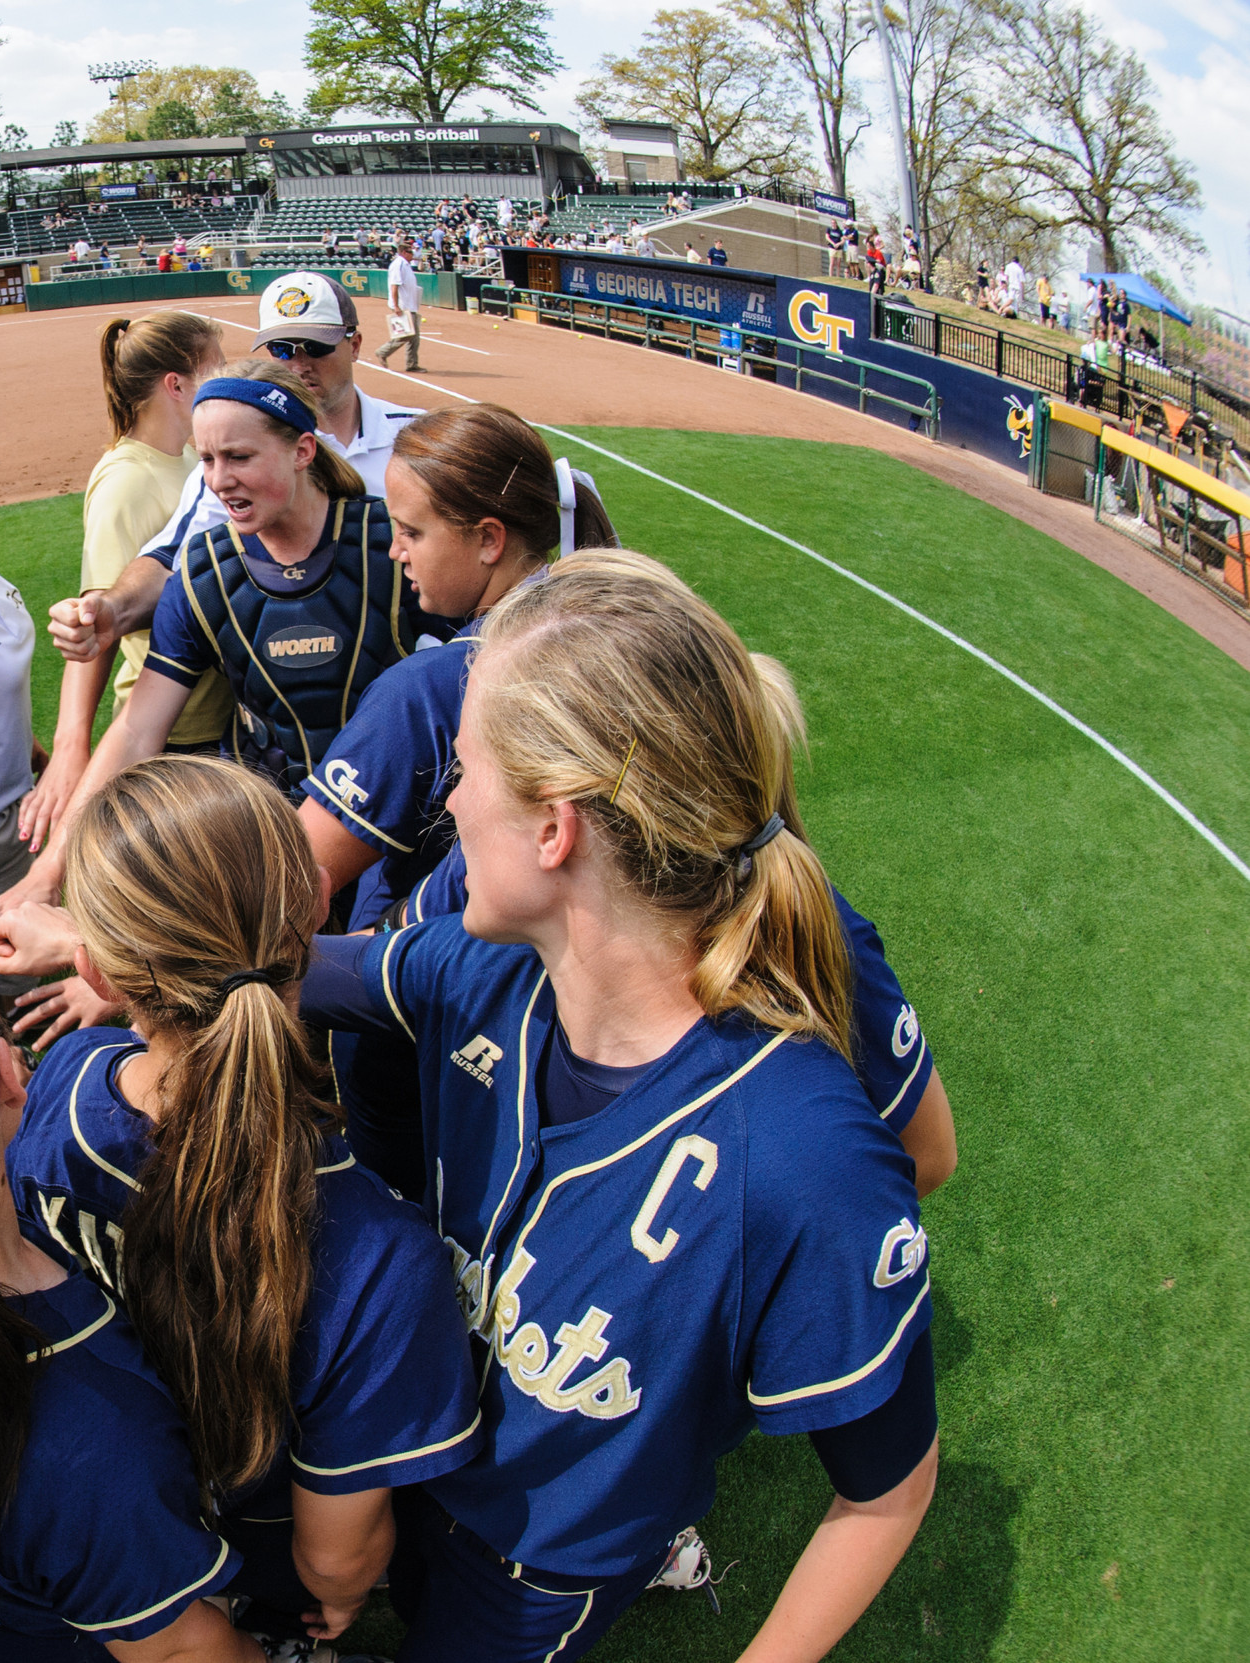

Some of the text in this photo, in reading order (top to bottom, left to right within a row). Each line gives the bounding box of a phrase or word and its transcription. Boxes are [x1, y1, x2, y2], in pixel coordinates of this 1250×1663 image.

[311, 128, 480, 146] Georgia Tech Softball
[227, 271, 251, 290] GT
[341, 270, 368, 291] GT
[595, 271, 721, 313] GEORGIA TECH
[742, 310, 772, 324] RUSSELL
[788, 289, 854, 363] GT
[283, 567, 307, 580] GT
[268, 636, 335, 657] WORTH
[324, 759, 370, 809] GT
[630, 1134, 718, 1263] C
